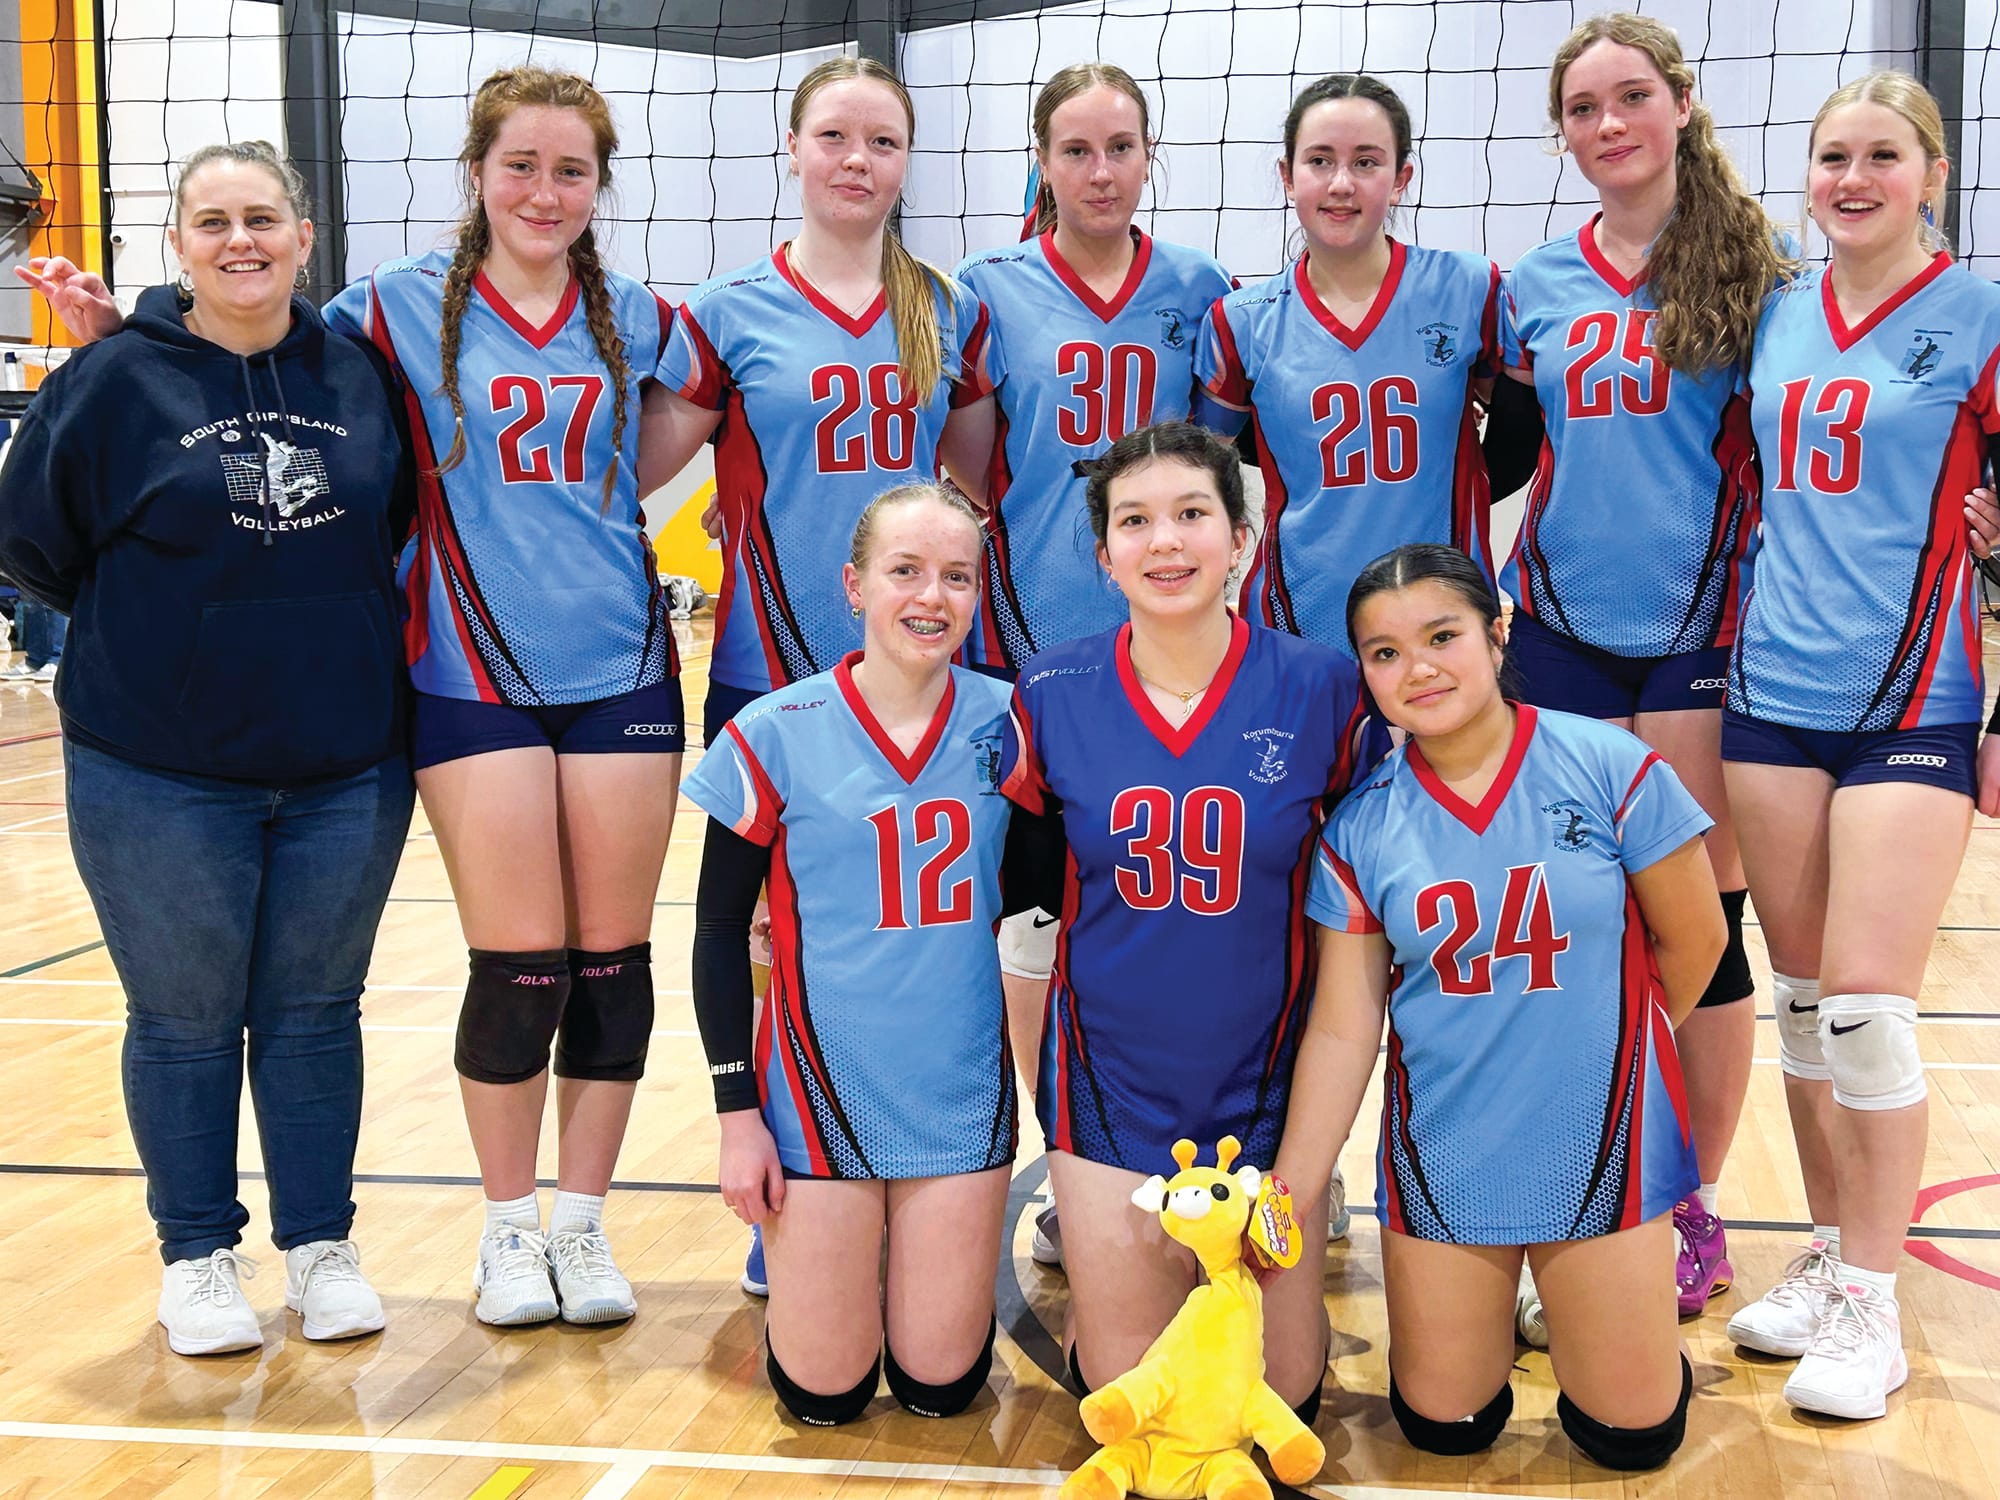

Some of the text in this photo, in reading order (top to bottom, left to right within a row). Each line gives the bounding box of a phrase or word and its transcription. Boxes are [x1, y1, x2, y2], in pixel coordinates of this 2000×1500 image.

[810, 362, 918, 474] 28
[1056, 339, 1158, 447] 30
[1564, 308, 1672, 420] 25
[180, 417, 240, 449] SOUTH
[488, 373, 606, 485] 27
[1310, 374, 1420, 489] 26
[1772, 375, 1873, 495] 13
[231, 506, 346, 532] VOLLEYBALL
[624, 724, 677, 736] JOUST
[1242, 727, 1295, 741] Korumburra
[1691, 678, 1728, 690] JOU
[1248, 769, 1289, 785] Volleyball
[1887, 754, 1947, 768] JOUST
[862, 797, 974, 931] 12
[1110, 785, 1245, 916] 39
[579, 964, 622, 977] JOUST
[1414, 861, 1571, 997] 24
